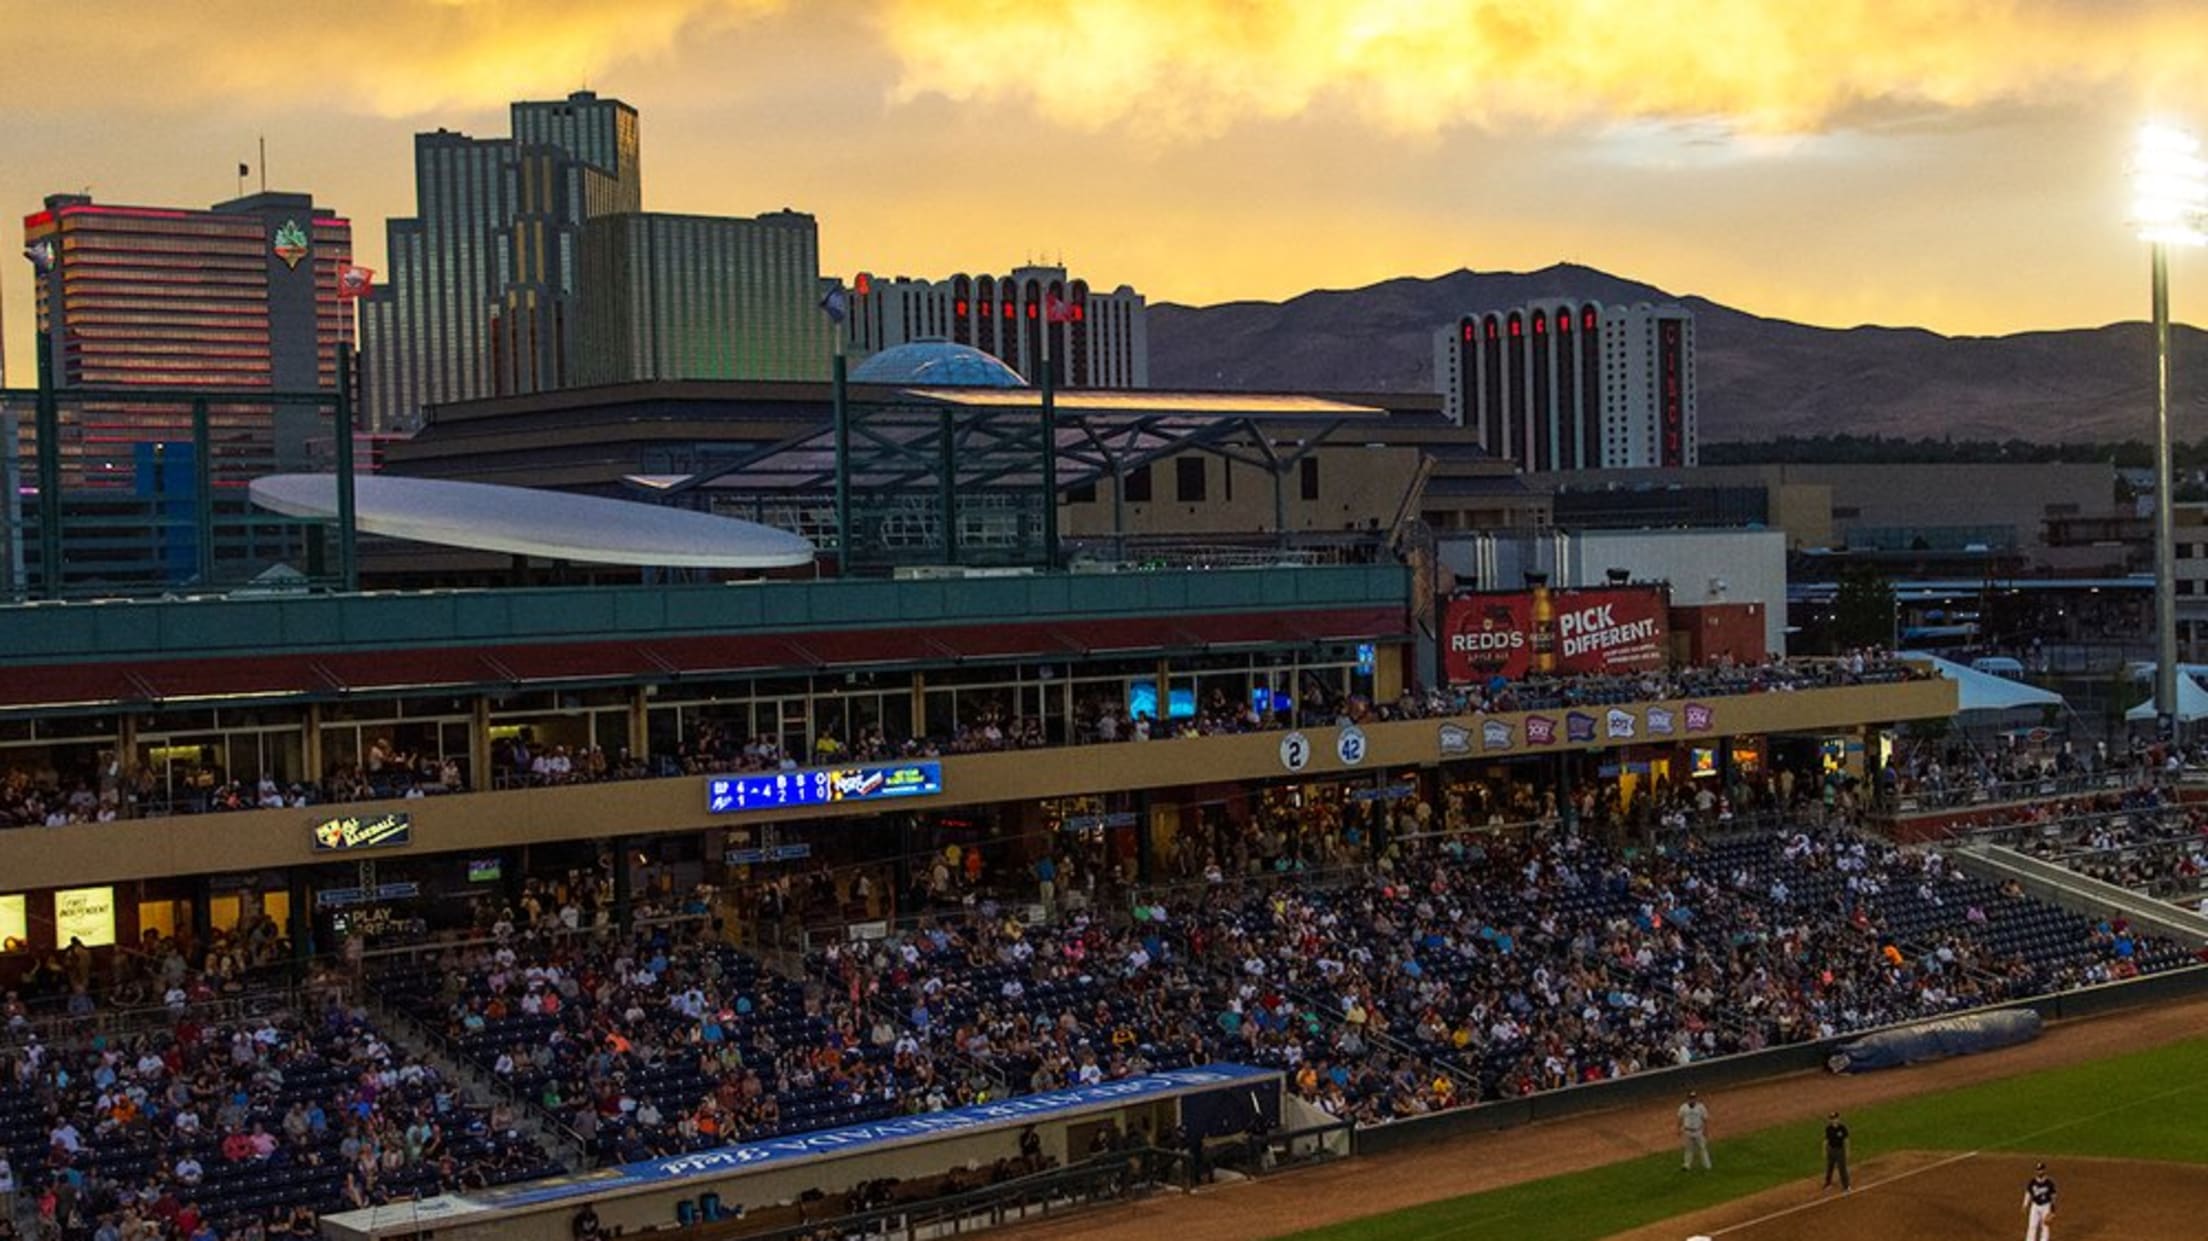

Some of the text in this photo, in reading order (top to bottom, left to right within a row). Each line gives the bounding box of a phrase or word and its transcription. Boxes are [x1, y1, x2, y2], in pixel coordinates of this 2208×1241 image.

[1560, 603, 1616, 637] PICK
[1562, 618, 1660, 657] DIFFERENT.
[1289, 742, 1301, 767] 2
[1342, 739, 1360, 760] 42
[763, 784, 771, 797] 4
[778, 789, 787, 803] 2
[799, 788, 805, 800] 1
[353, 907, 392, 923] PLAY
